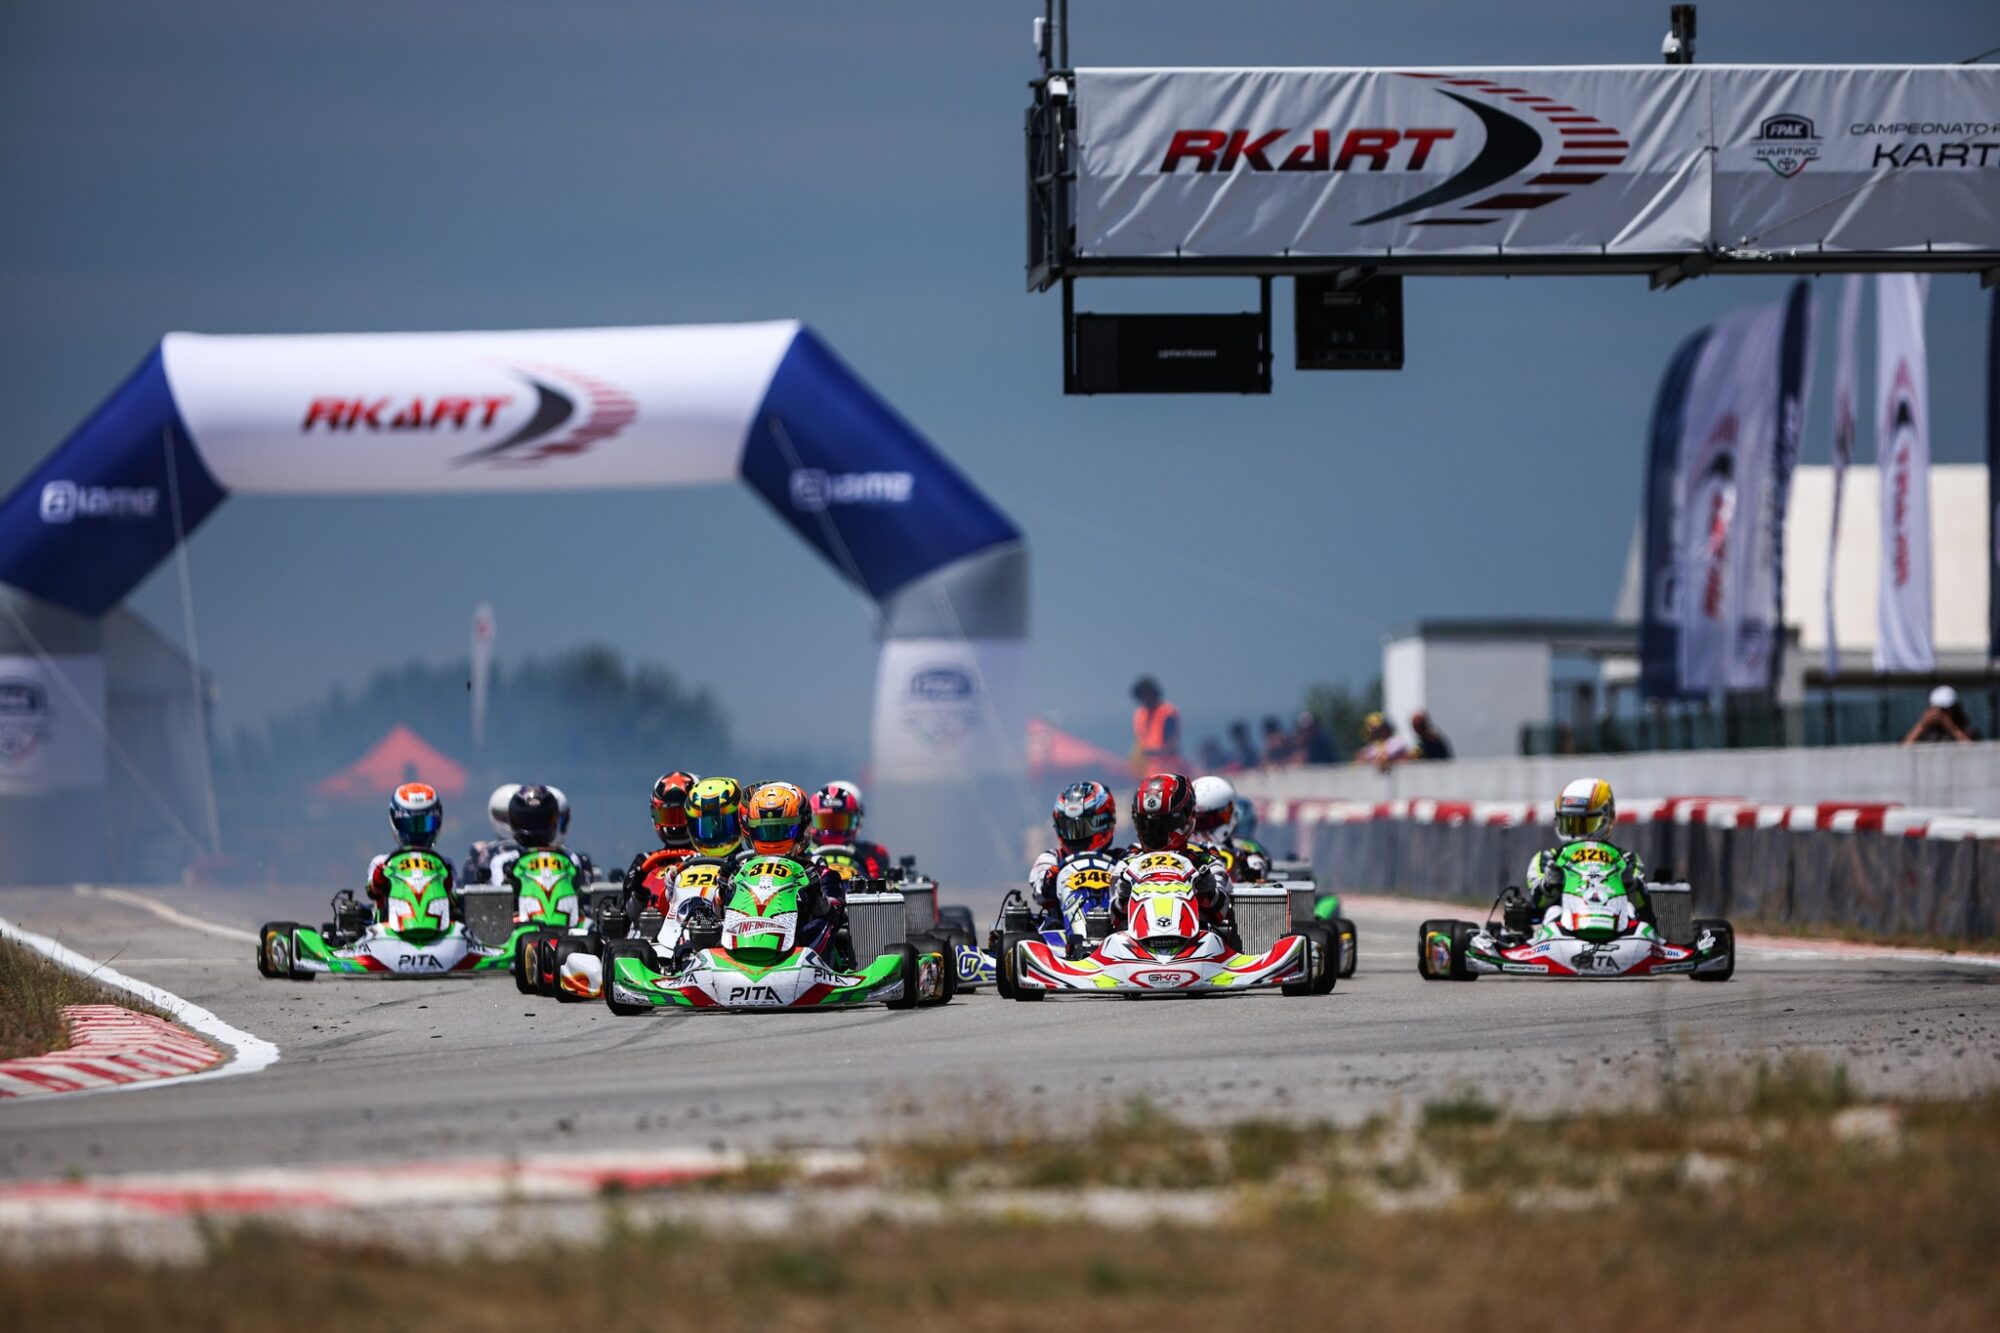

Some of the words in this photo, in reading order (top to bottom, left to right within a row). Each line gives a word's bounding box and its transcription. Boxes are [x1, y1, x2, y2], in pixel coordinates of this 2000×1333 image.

[1769, 124, 1803, 136] FPAK
[1850, 122, 1989, 136] CAMPEONATO
[1159, 128, 1456, 173] RKART
[1757, 147, 1818, 156] KARTING
[1872, 142, 2000, 168] KART
[302, 395, 512, 432] RKART
[749, 863, 789, 878] 315
[1140, 856, 1184, 870] 322
[398, 954, 444, 969] PITA
[814, 969, 848, 986] PITA
[730, 986, 783, 1003] PITA
